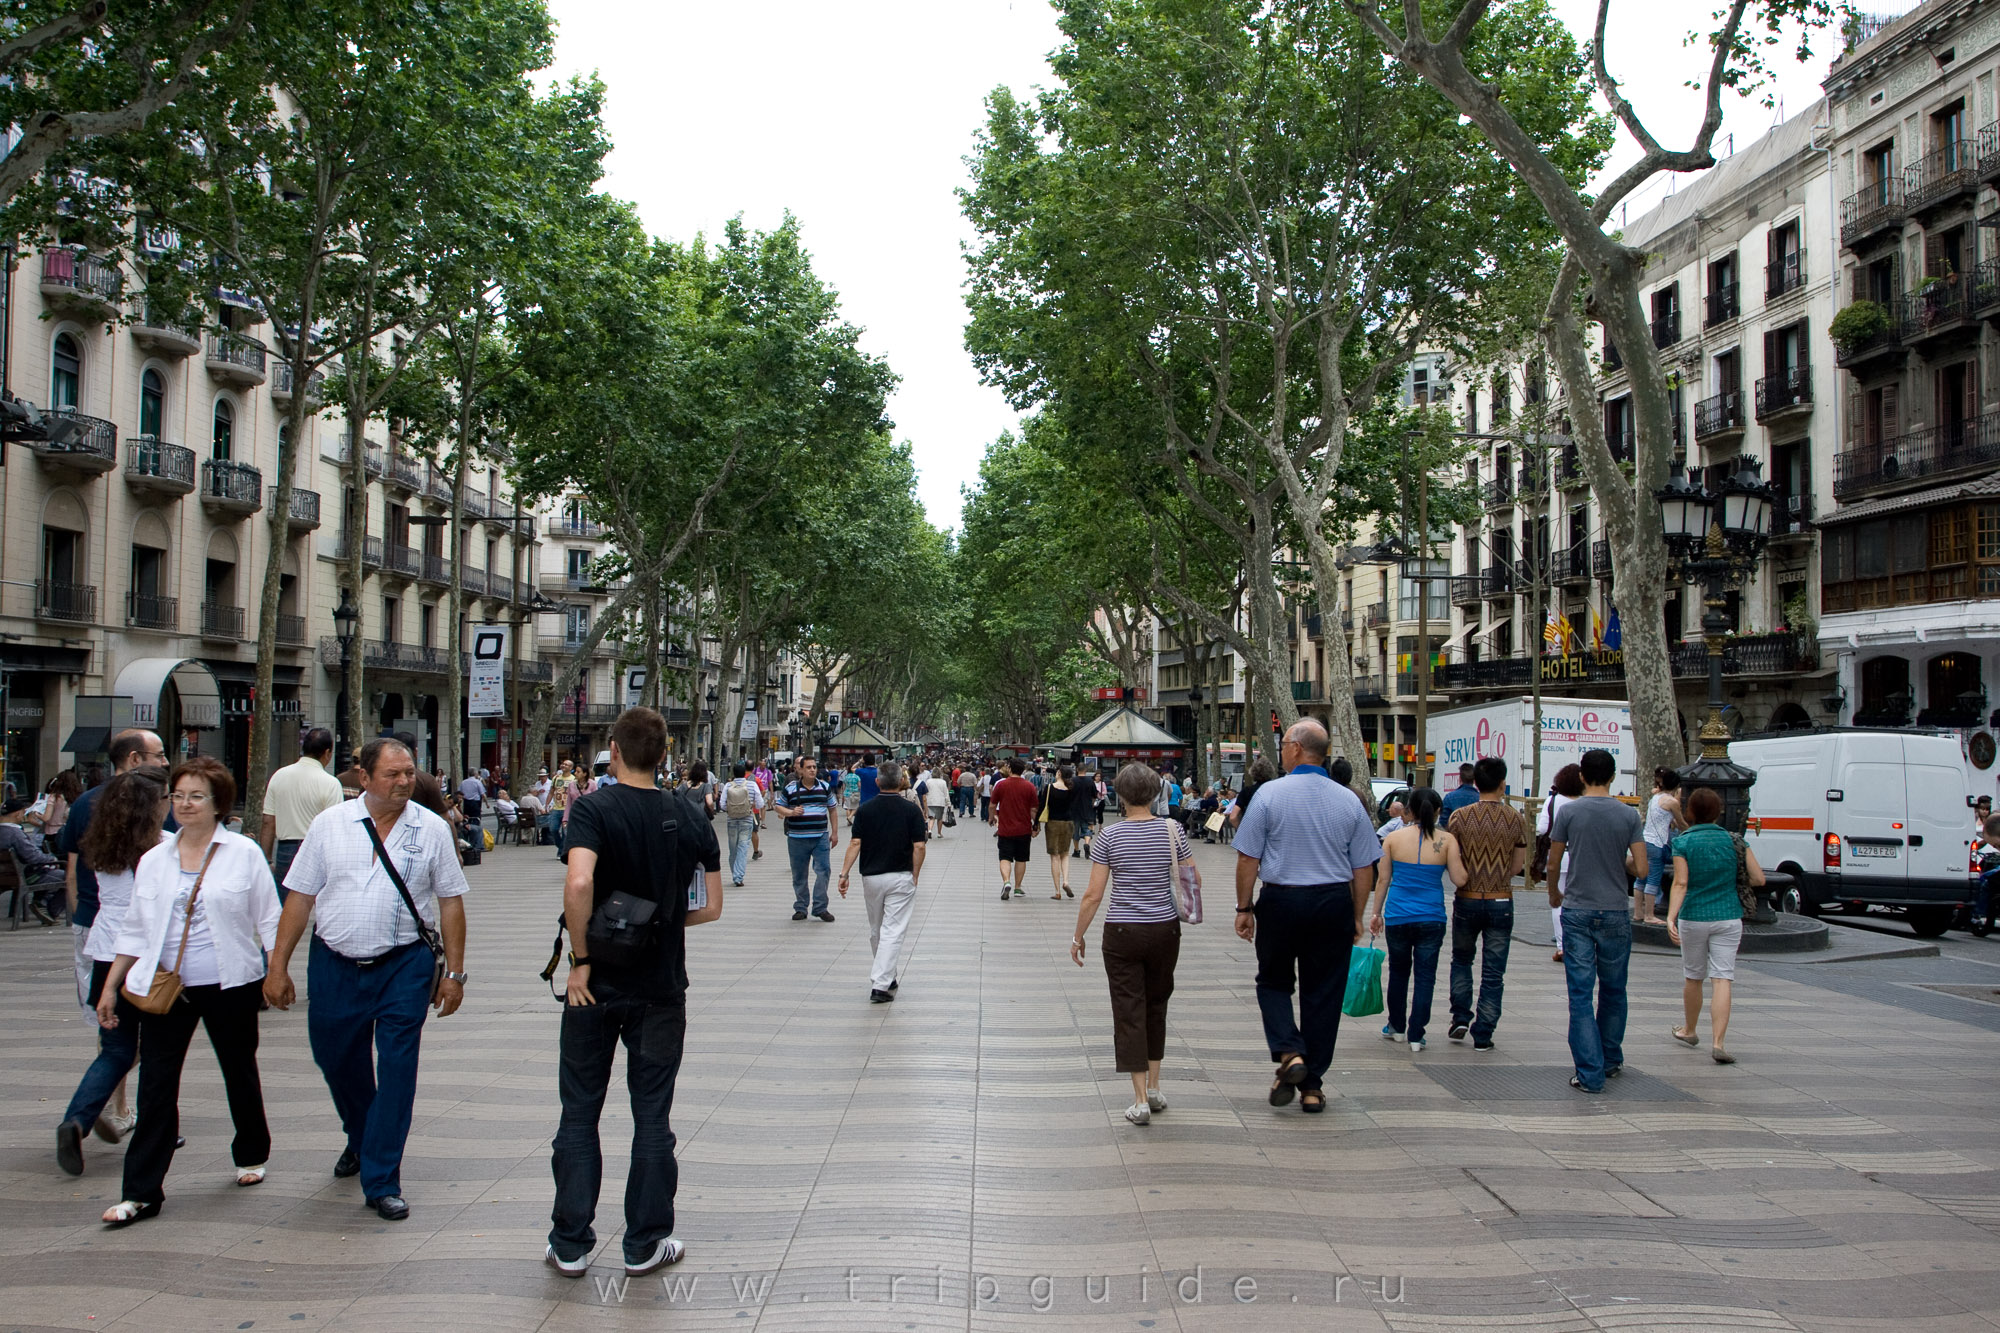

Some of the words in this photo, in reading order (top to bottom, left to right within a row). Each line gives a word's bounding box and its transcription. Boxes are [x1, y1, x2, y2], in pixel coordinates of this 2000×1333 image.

[1778, 571, 1805, 583] HOTEL
[1541, 657, 1587, 679] HOTEL
[1597, 650, 1624, 665] LLOR
[133, 704, 154, 721] TEL
[1858, 846, 1878, 855] 4278
[1880, 847, 1895, 856] FZG
